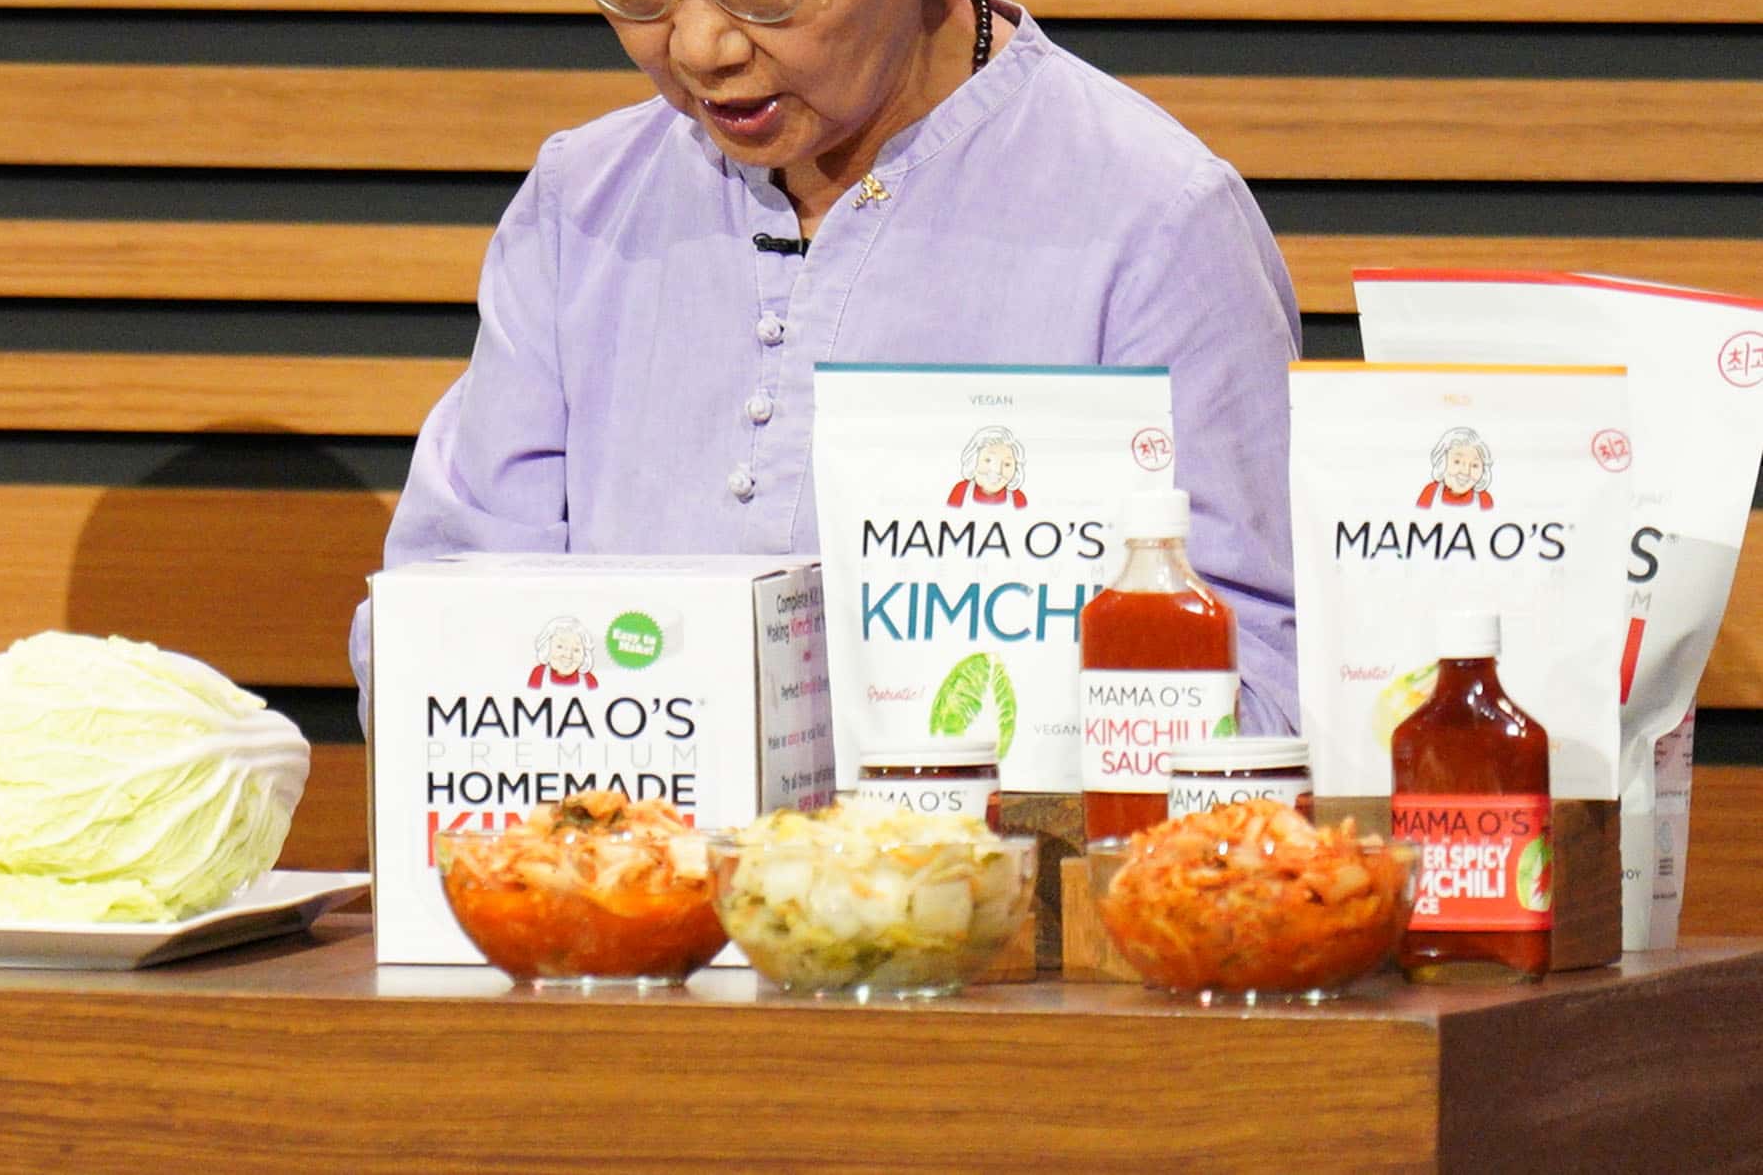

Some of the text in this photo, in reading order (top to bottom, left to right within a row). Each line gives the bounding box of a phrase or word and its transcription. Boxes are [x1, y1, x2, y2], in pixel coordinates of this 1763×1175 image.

[969, 394, 1013, 406] VEGAN
[862, 519, 1106, 560] MAMA O'S
[1336, 520, 1567, 561] MAMA O'S
[862, 581, 1104, 641] KIMCH
[1089, 685, 1203, 708] MAMA O'S
[427, 696, 696, 740] MAMA O'S
[427, 741, 698, 769] PREMIUM
[1101, 749, 1174, 776] SAUC
[427, 772, 697, 805] HOMEMADE
[919, 790, 963, 812] O'S
[1391, 809, 1530, 836] MAMA O'S
[1448, 843, 1513, 870] SPICY
